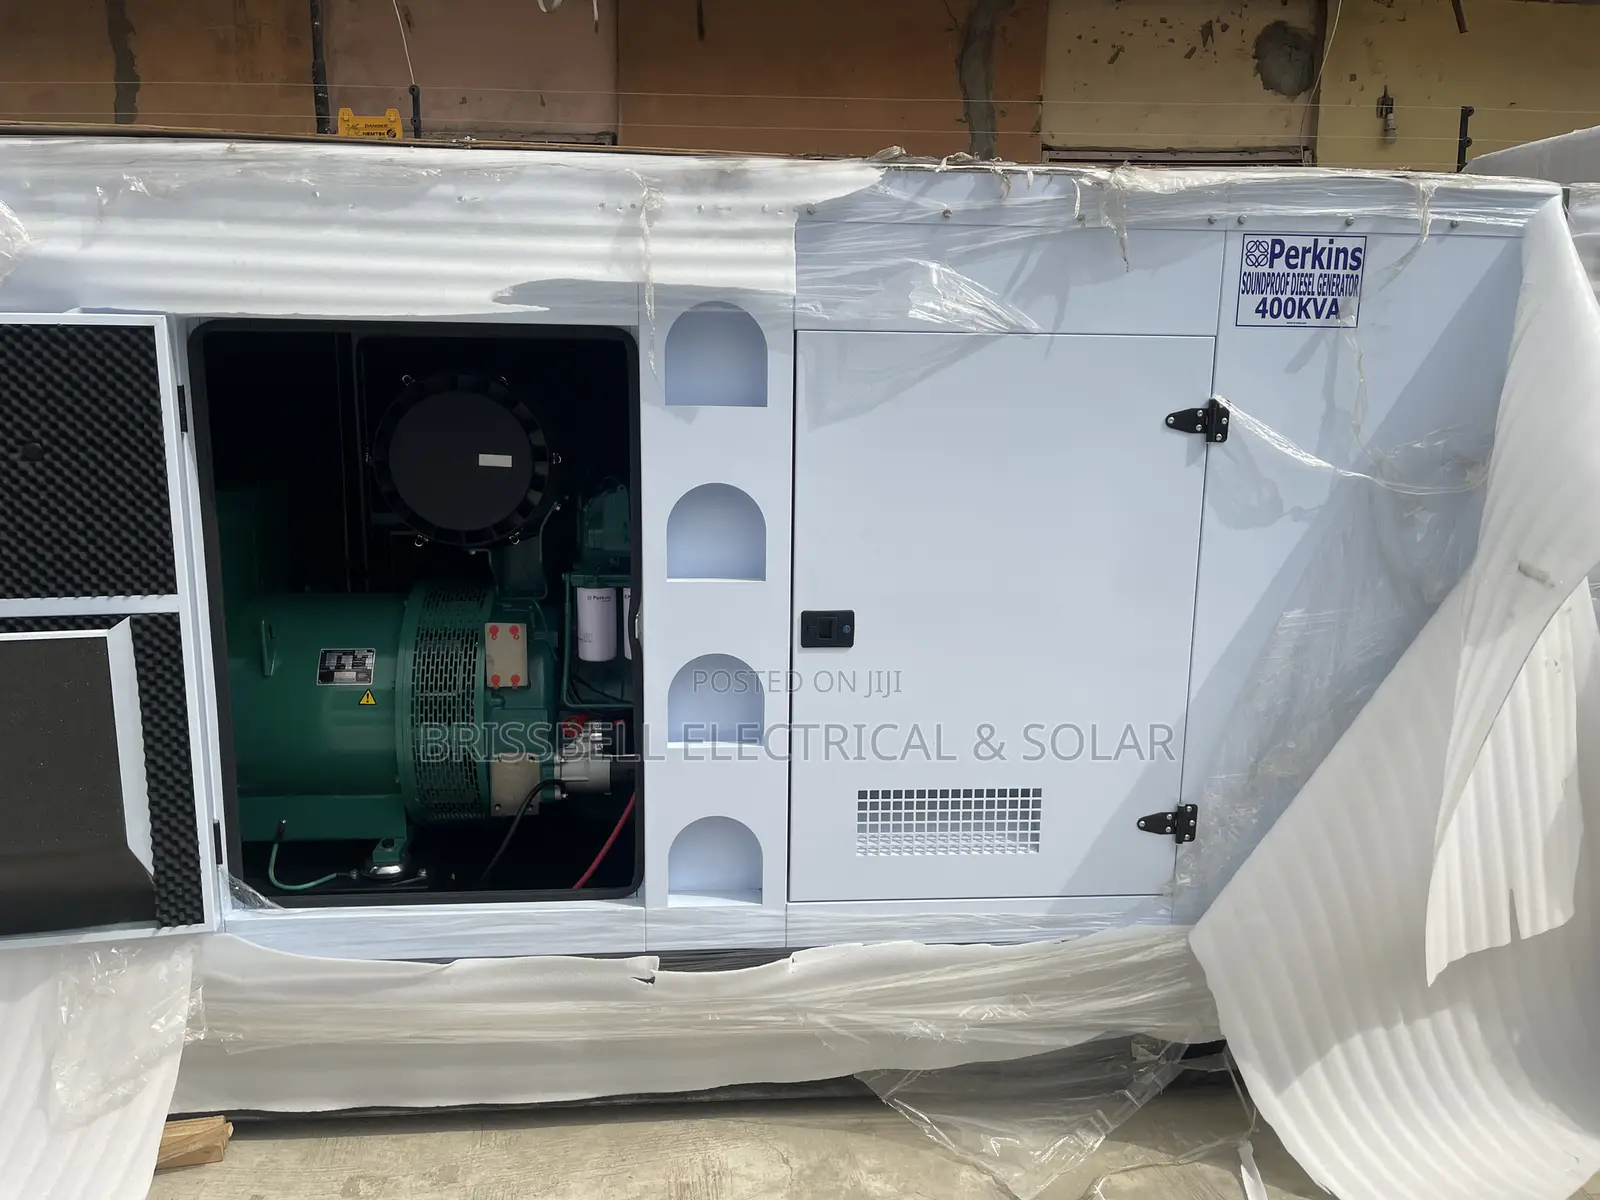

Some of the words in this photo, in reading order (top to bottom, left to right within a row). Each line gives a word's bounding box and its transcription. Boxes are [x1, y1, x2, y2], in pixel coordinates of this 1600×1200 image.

[1268, 238, 1363, 271] Perkins
[1241, 271, 1290, 295] SOUNDPROOF
[1291, 272, 1315, 296] DIESEL
[1317, 273, 1359, 298] GENERATOR
[1254, 297, 1340, 320] 400KVA
